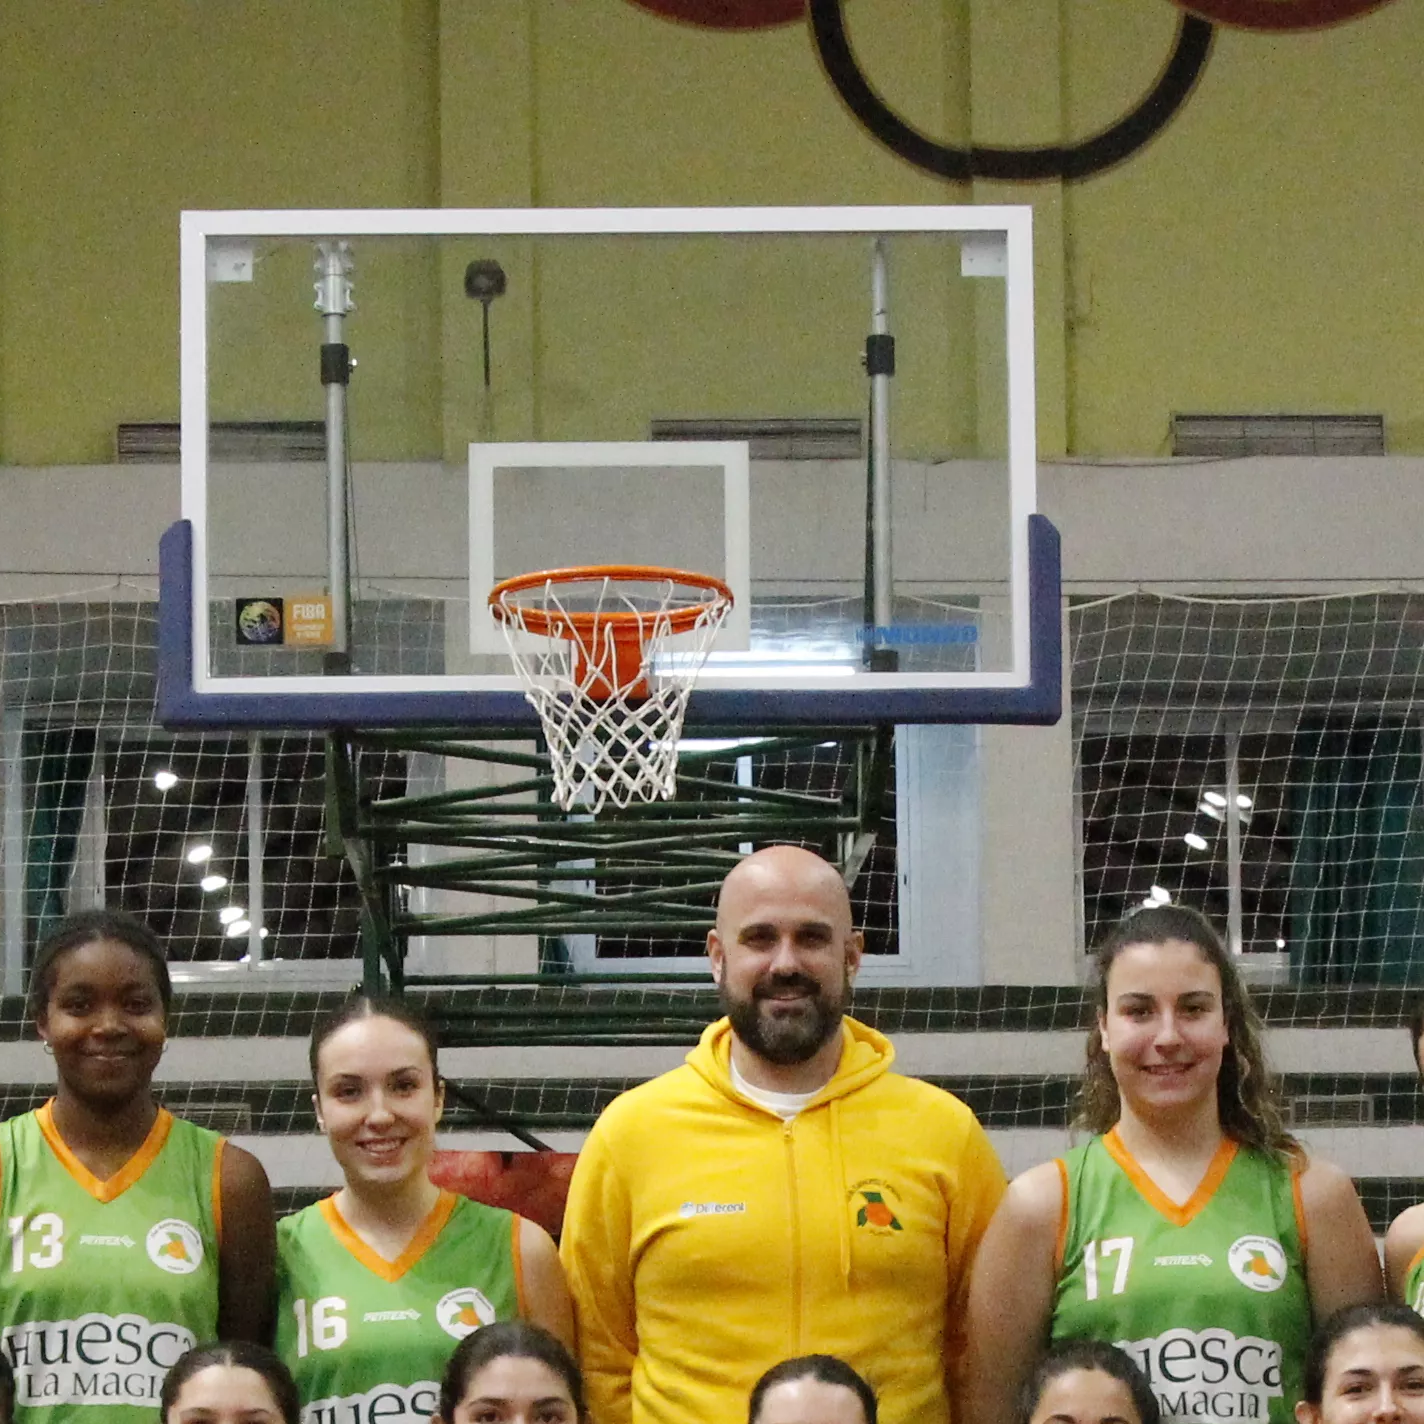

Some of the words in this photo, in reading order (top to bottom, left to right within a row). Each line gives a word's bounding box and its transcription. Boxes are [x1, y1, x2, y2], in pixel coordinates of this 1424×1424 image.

[8, 1213, 64, 1273] 13
[1083, 1236, 1134, 1300] 17
[3, 1320, 193, 1368] Huesc
[293, 1297, 347, 1357] 16
[27, 1372, 60, 1398] La
[1144, 1337, 1281, 1387] esca
